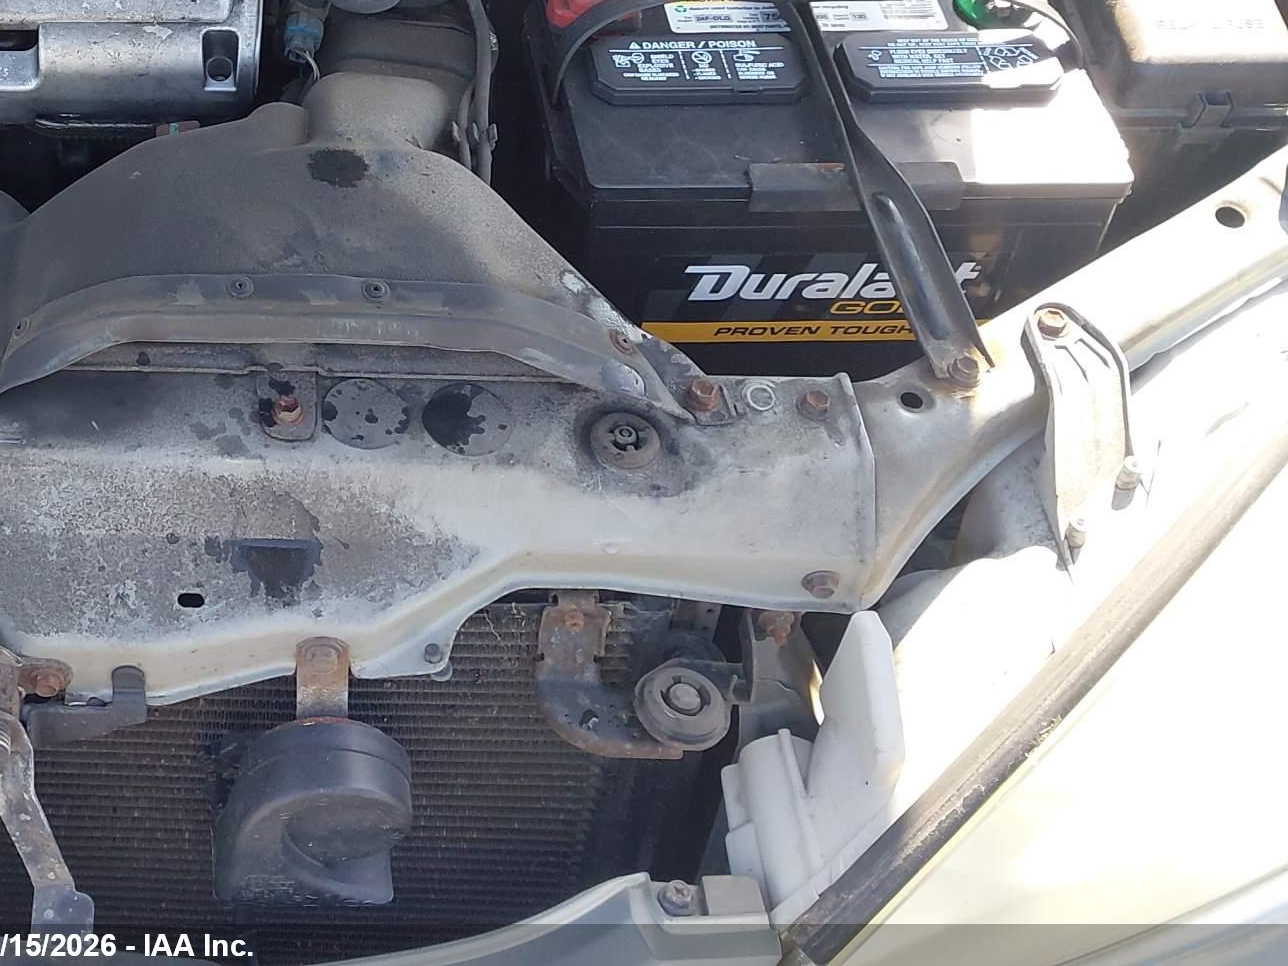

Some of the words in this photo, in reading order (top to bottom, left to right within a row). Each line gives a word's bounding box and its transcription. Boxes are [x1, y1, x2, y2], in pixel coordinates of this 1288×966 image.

[642, 40, 696, 50] DANGER
[708, 39, 757, 49] POISON
[684, 262, 981, 301] Duralat
[829, 300, 905, 315] GO
[713, 325, 823, 336] PROVEN
